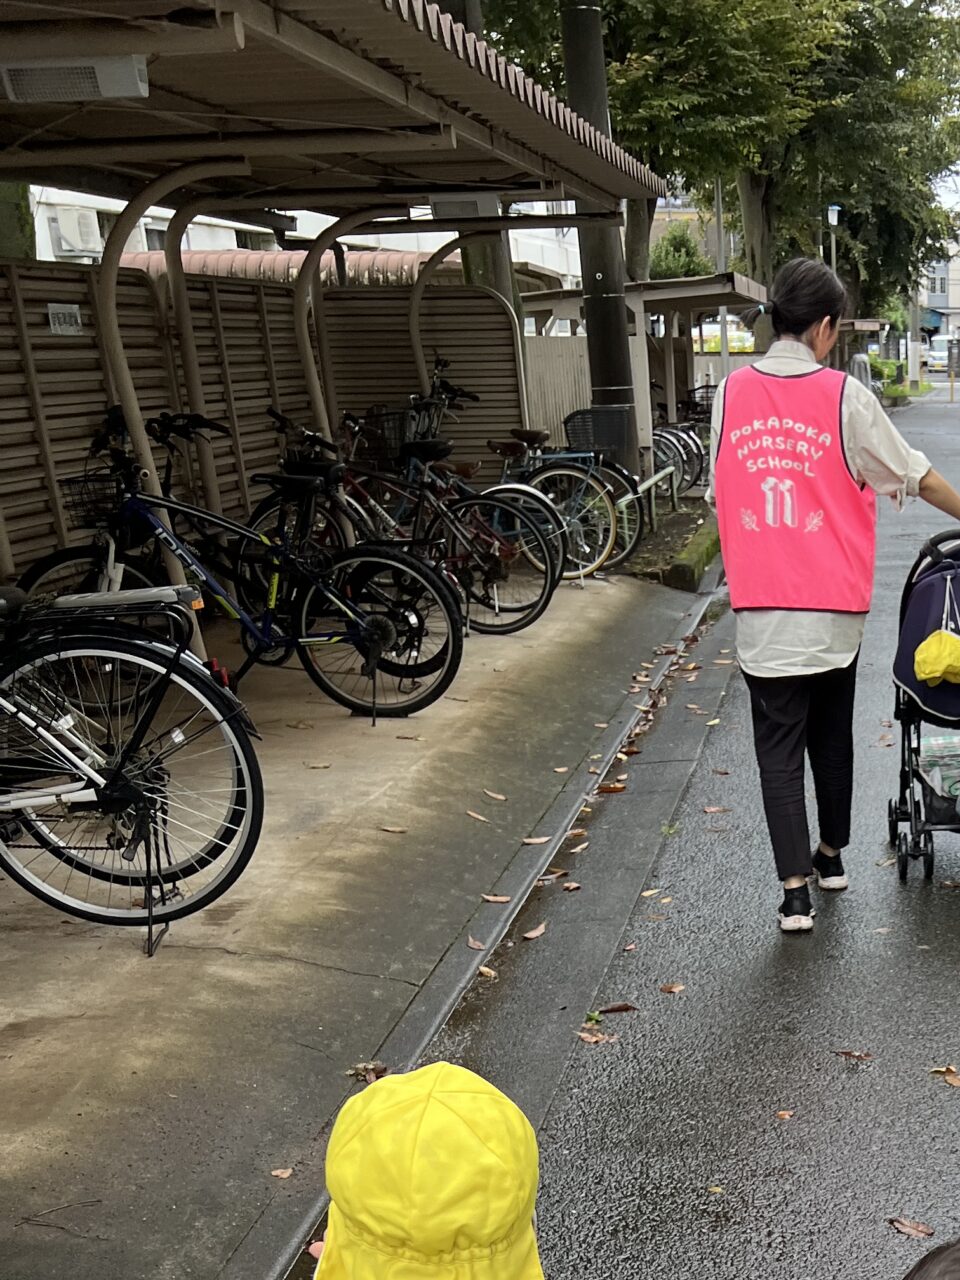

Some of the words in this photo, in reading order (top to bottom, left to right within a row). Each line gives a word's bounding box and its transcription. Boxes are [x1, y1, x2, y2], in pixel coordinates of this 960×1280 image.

[730, 416, 832, 446] POKAPOKA
[737, 436, 823, 460] NURSERY
[746, 456, 815, 477] SCHOOL
[761, 476, 798, 528] 11
